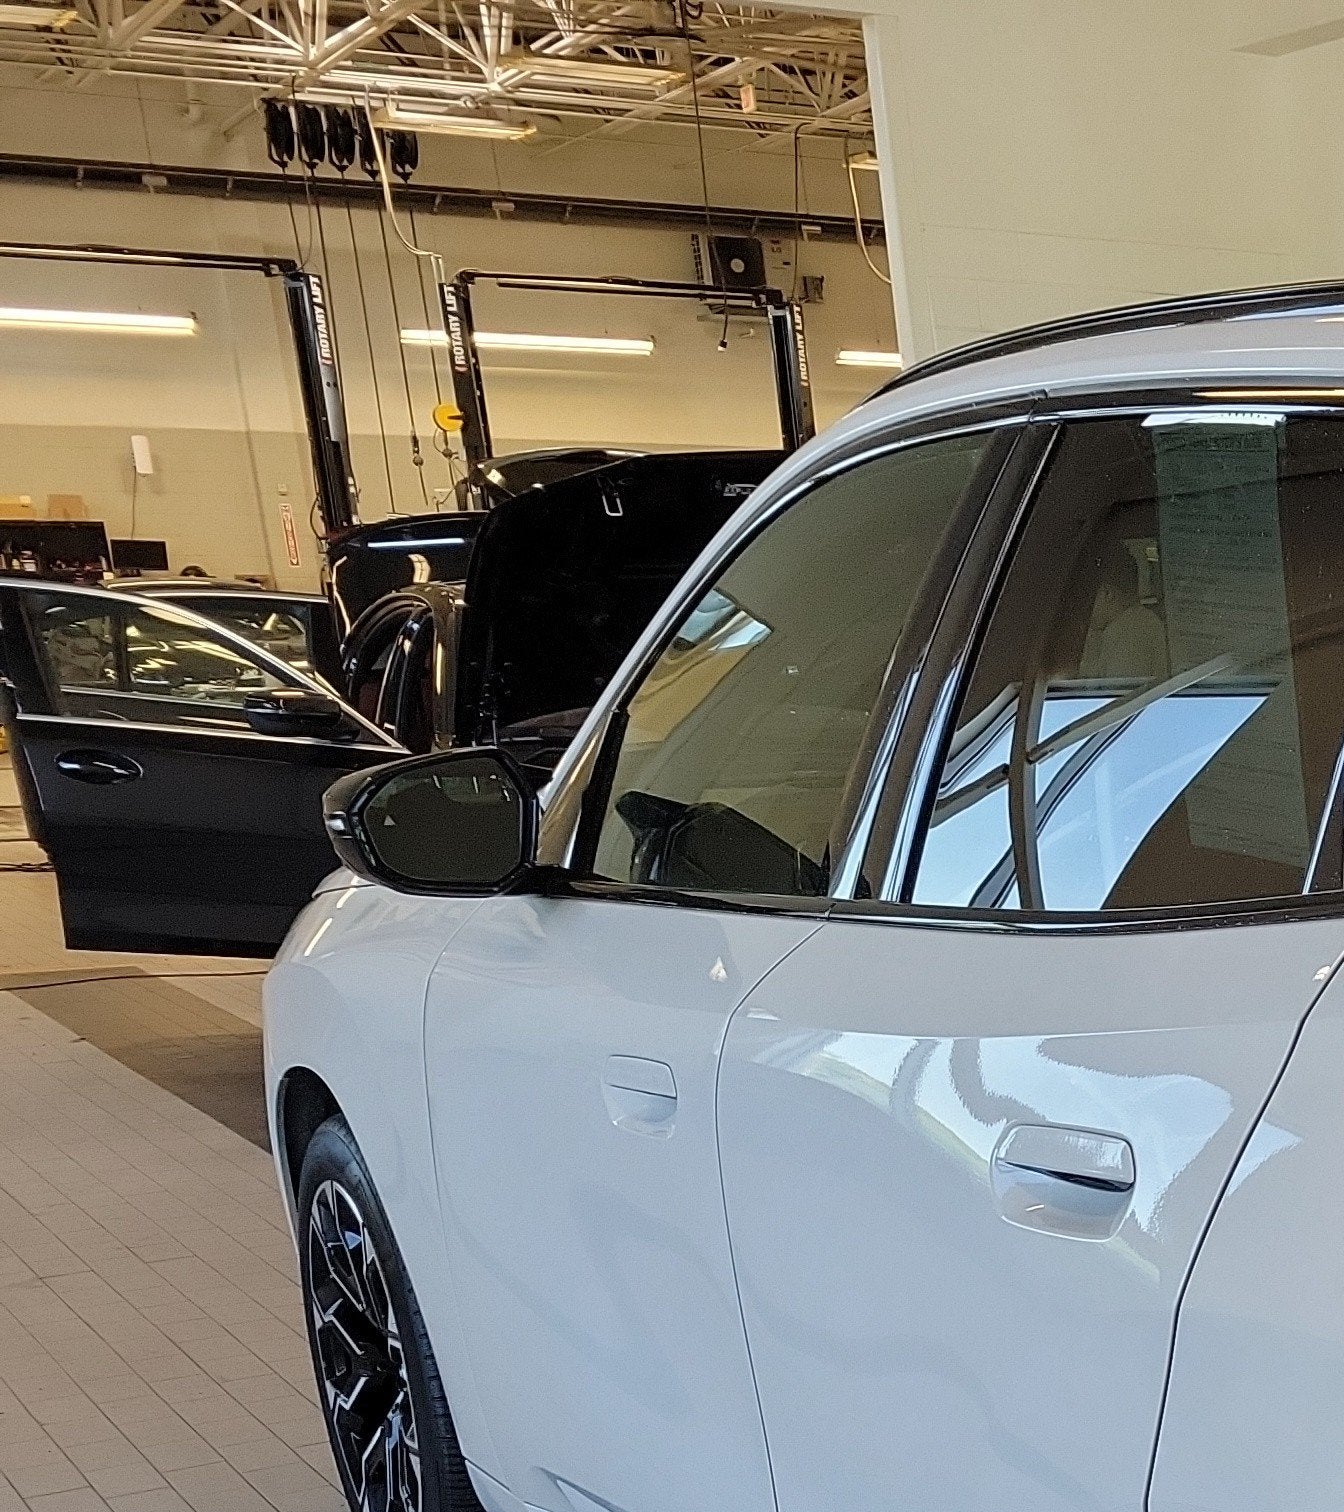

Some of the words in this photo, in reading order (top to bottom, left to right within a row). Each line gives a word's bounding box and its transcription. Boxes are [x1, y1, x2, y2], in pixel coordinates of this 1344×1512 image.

[308, 274, 325, 304] LIFT
[444, 284, 458, 312] LIFT
[314, 305, 333, 358] ROTARY
[793, 304, 803, 331] LIFT
[448, 313, 467, 366] ROTARY
[796, 331, 810, 380] ROTARY
